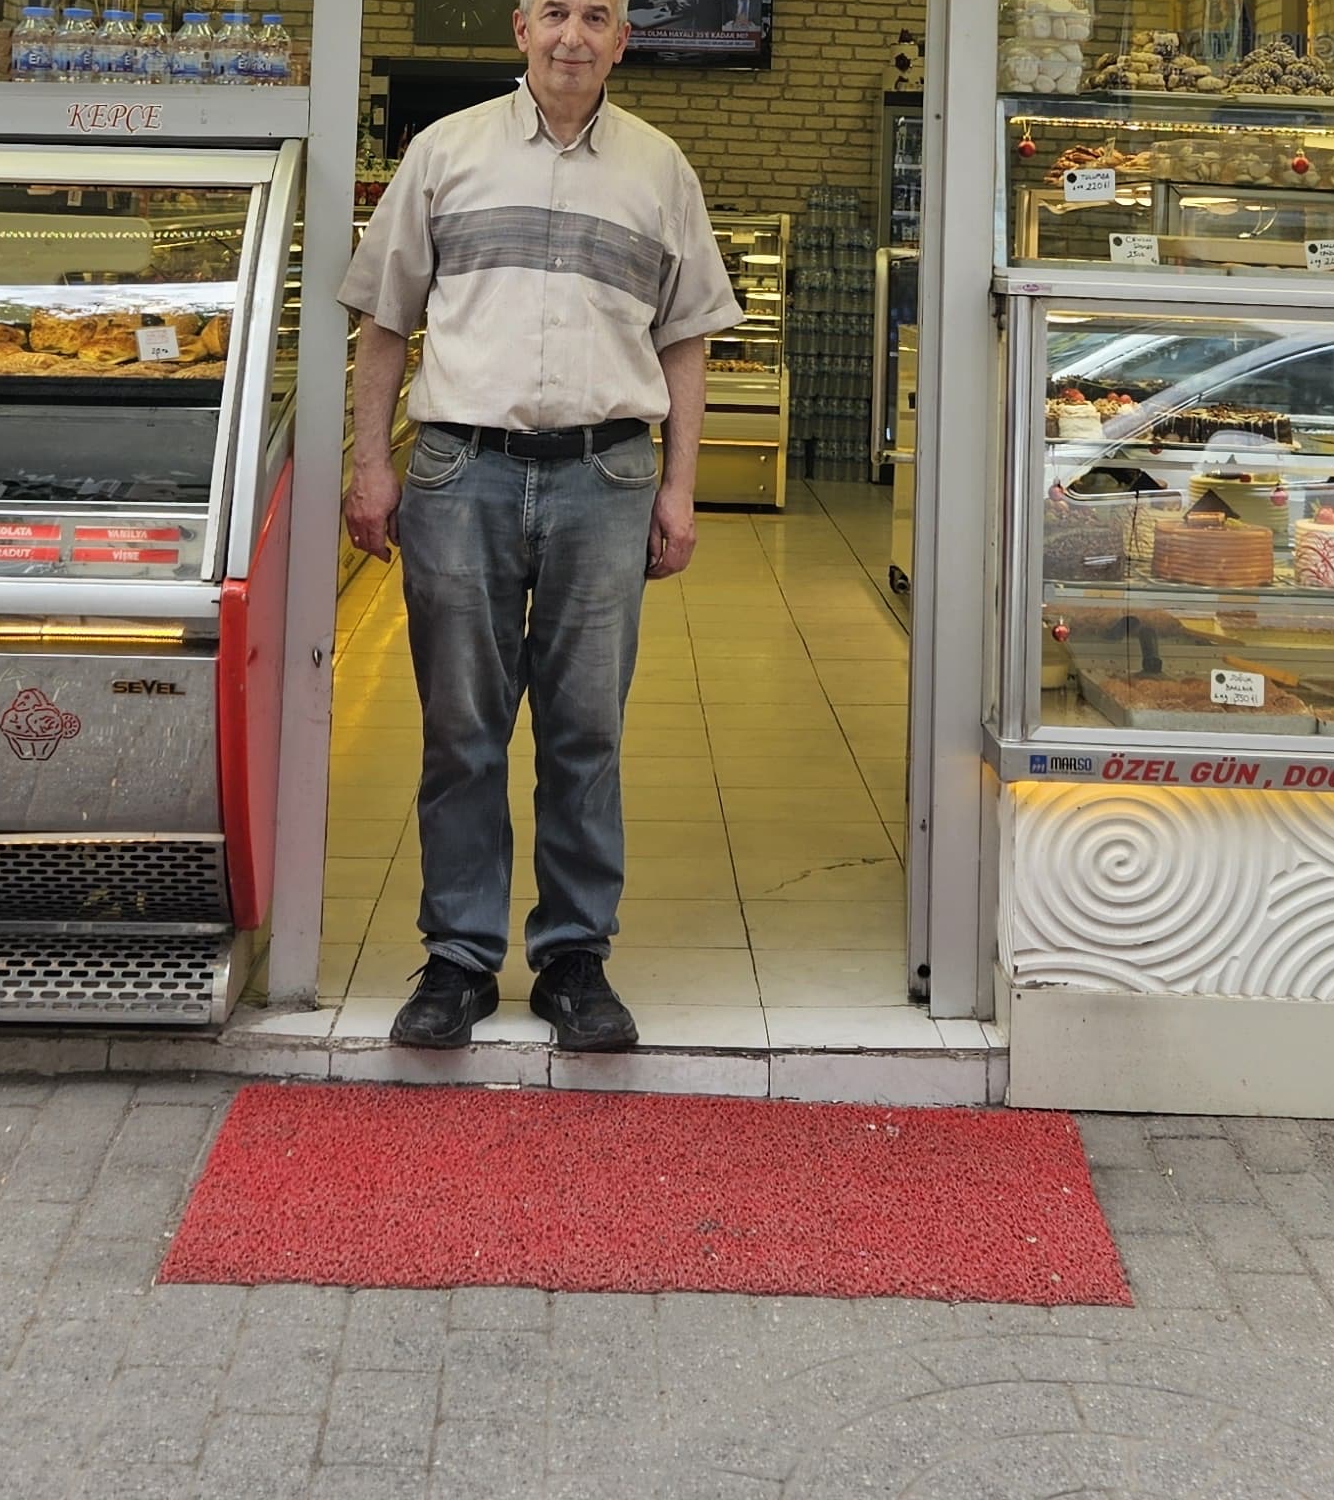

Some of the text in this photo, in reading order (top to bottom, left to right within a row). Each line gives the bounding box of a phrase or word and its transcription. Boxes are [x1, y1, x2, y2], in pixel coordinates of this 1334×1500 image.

[67, 102, 163, 134] KEPÇE
[112, 679, 187, 697] SEVEL
[1050, 756, 1093, 772] MARSO
[1101, 752, 1180, 783] ÖZEL
[1189, 756, 1260, 785] GÜN
